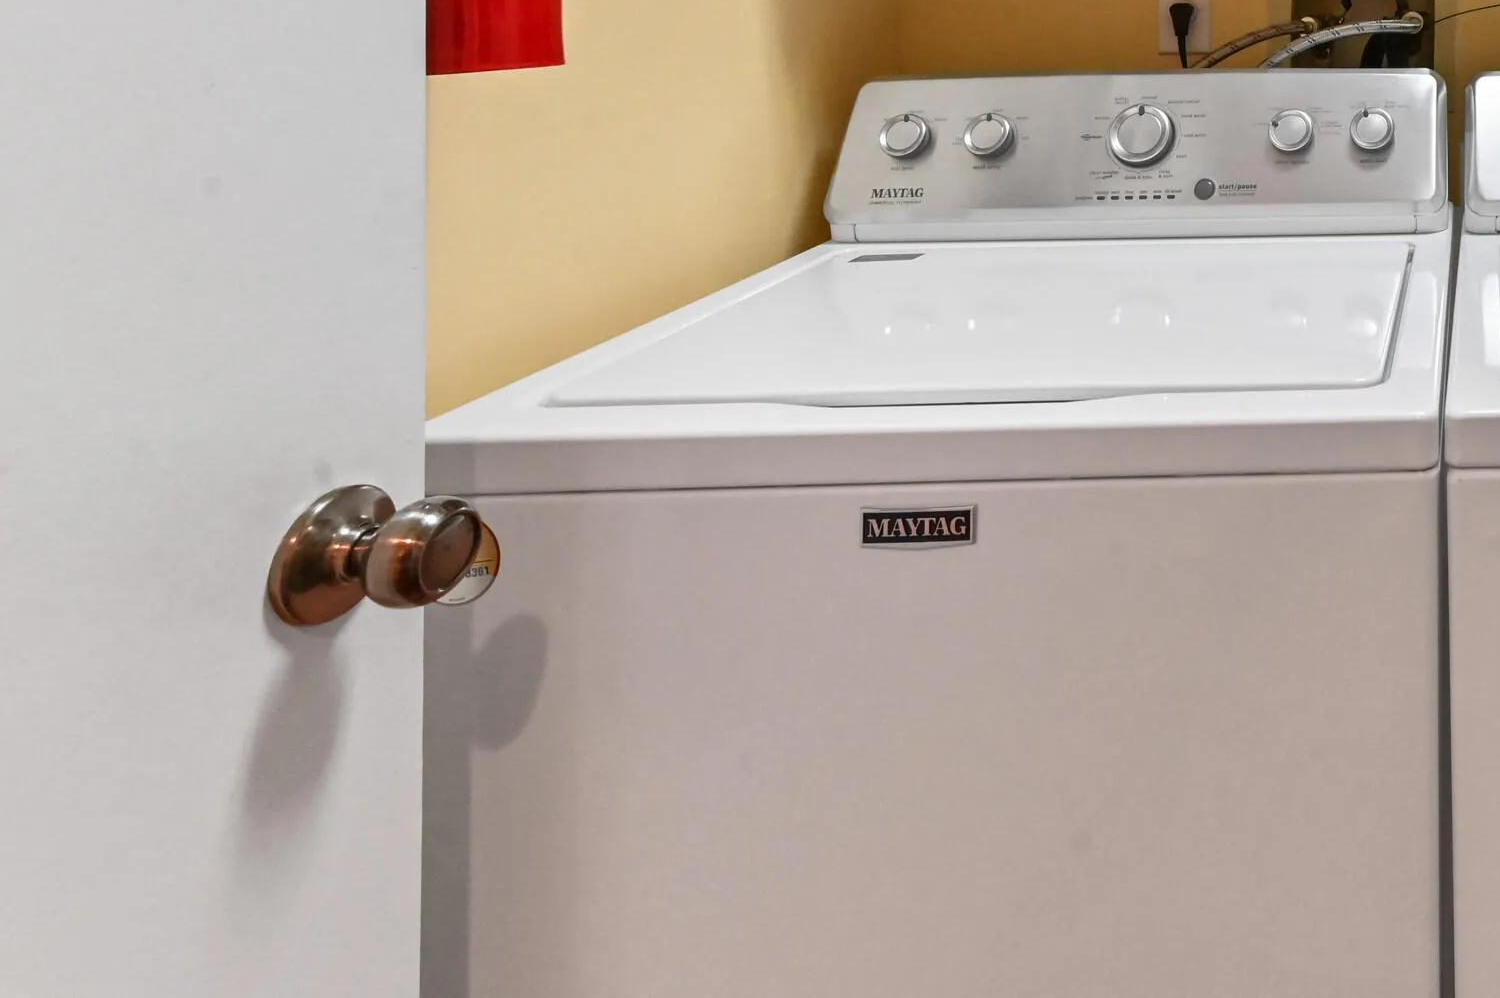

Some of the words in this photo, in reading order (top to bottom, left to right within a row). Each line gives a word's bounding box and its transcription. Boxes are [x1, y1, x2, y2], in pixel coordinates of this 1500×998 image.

[1218, 182, 1257, 190] start/pause
[871, 187, 924, 199] MAYTAG
[867, 516, 967, 538] MAYTAG
